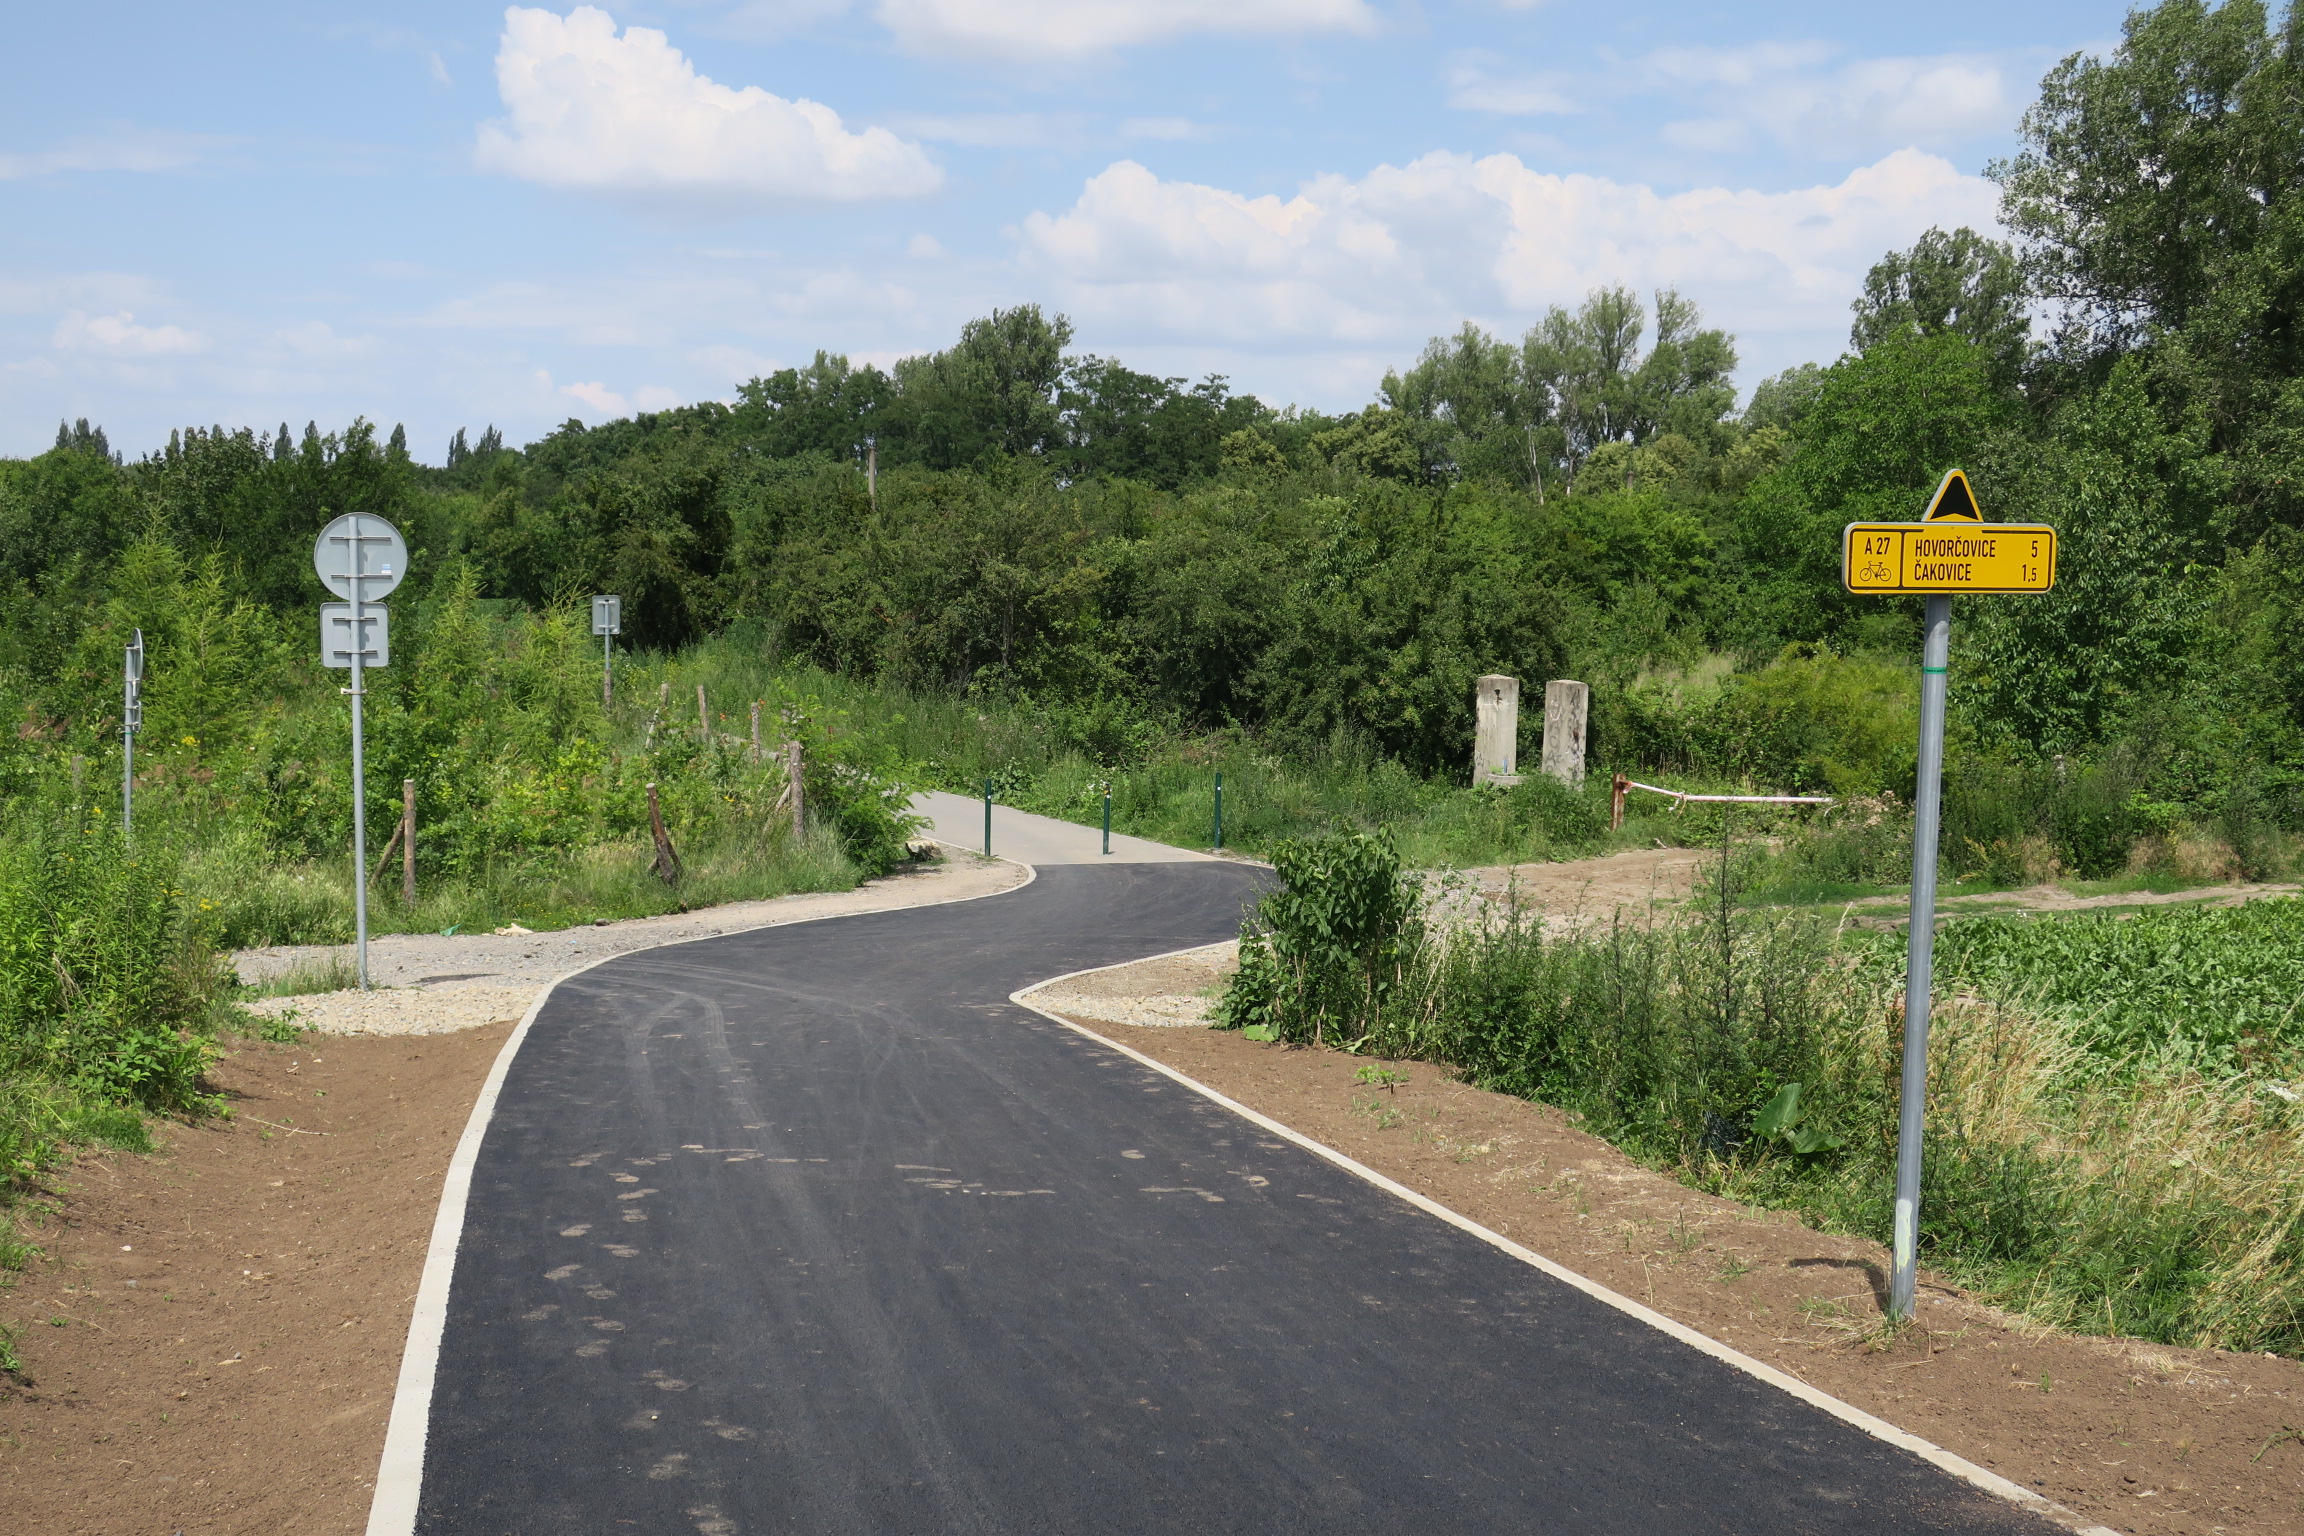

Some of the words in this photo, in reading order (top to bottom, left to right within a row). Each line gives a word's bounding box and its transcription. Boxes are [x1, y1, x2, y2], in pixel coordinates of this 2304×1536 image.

[1864, 537, 1873, 555] A
[1876, 537, 1891, 555] 27
[1915, 535, 1996, 558] HOVORČOVICE
[2031, 540, 2039, 558] 5
[1914, 559, 1972, 582] ČAKOVICE
[2021, 564, 2037, 583] 1,5
